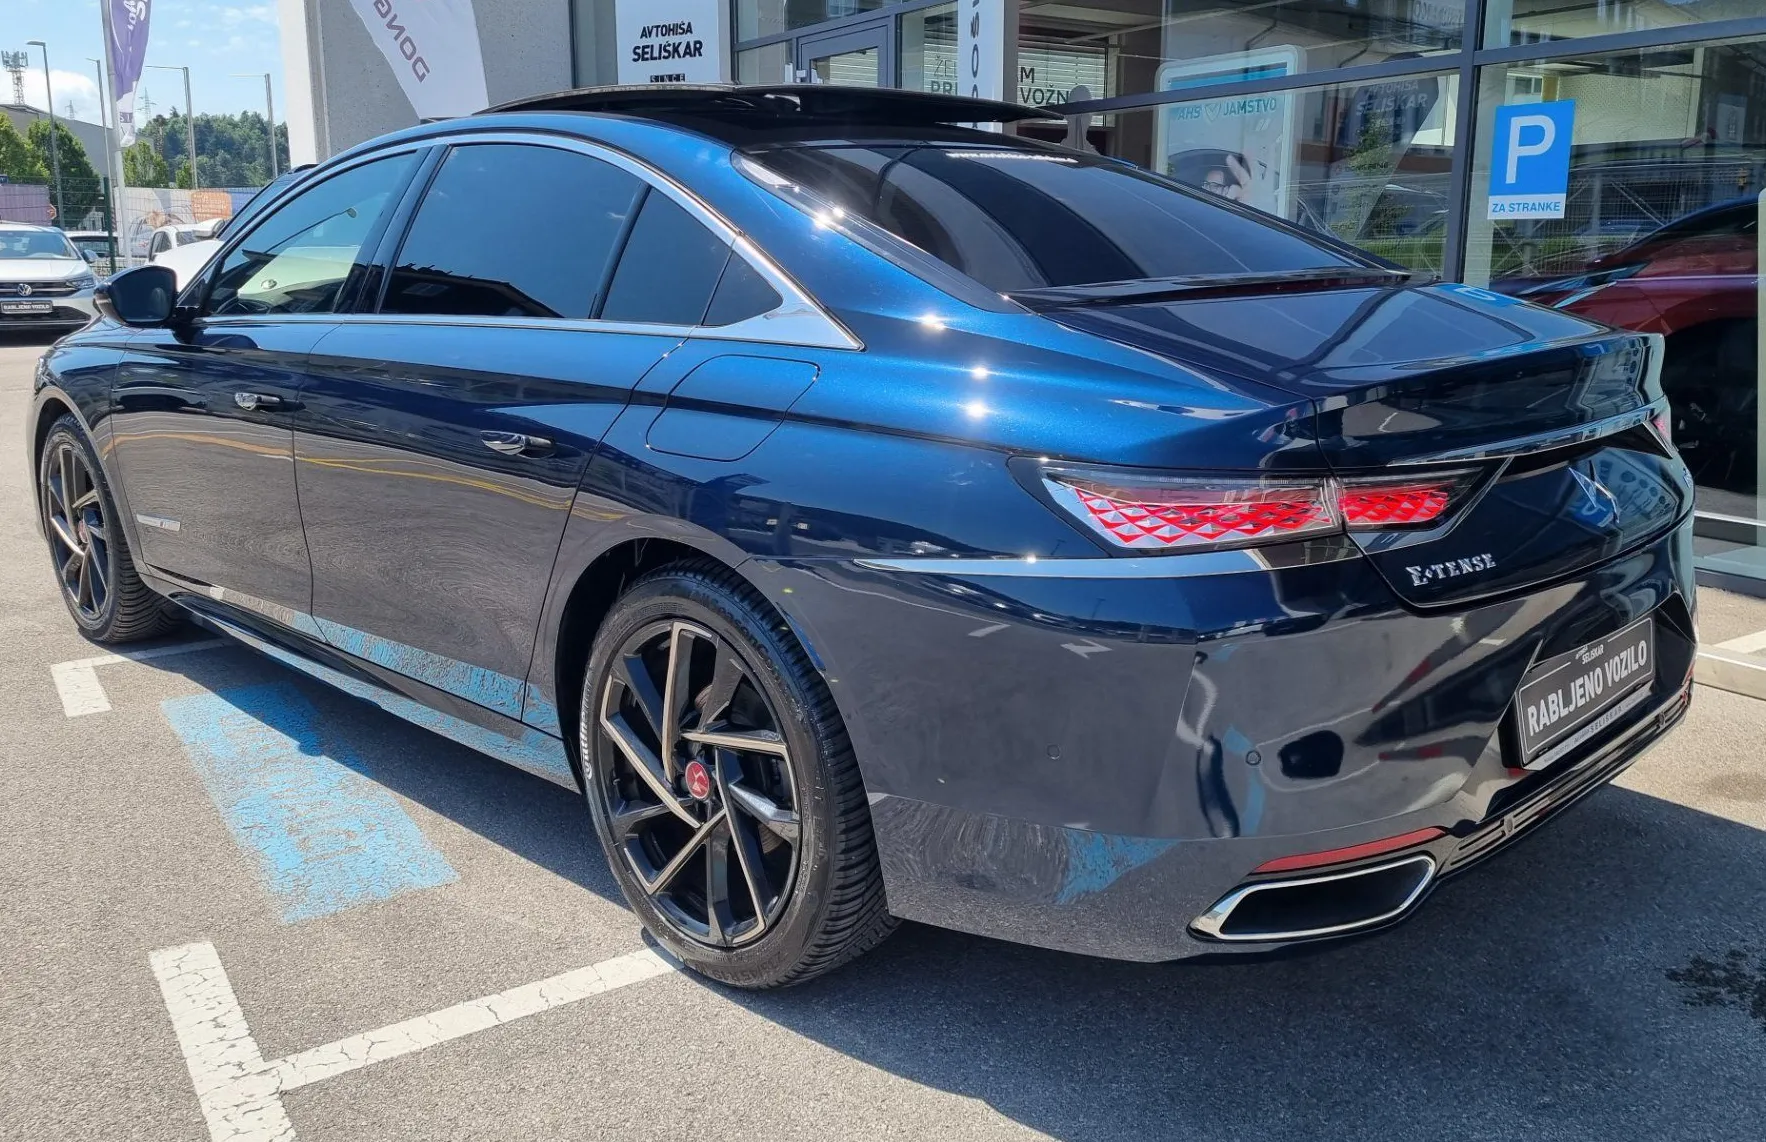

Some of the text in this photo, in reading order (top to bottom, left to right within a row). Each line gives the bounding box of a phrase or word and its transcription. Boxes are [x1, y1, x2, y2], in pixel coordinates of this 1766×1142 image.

[640, 21, 693, 39] AVTOHIŠA
[632, 40, 703, 62] SELIŠKAR
[649, 73, 686, 83] SINCE
[1223, 98, 1276, 116] JAMSTVO
[1506, 115, 1556, 184] P
[1492, 201, 1561, 213] ZA STRANKE
[1527, 640, 1647, 736] RABLJENO VOZILO
